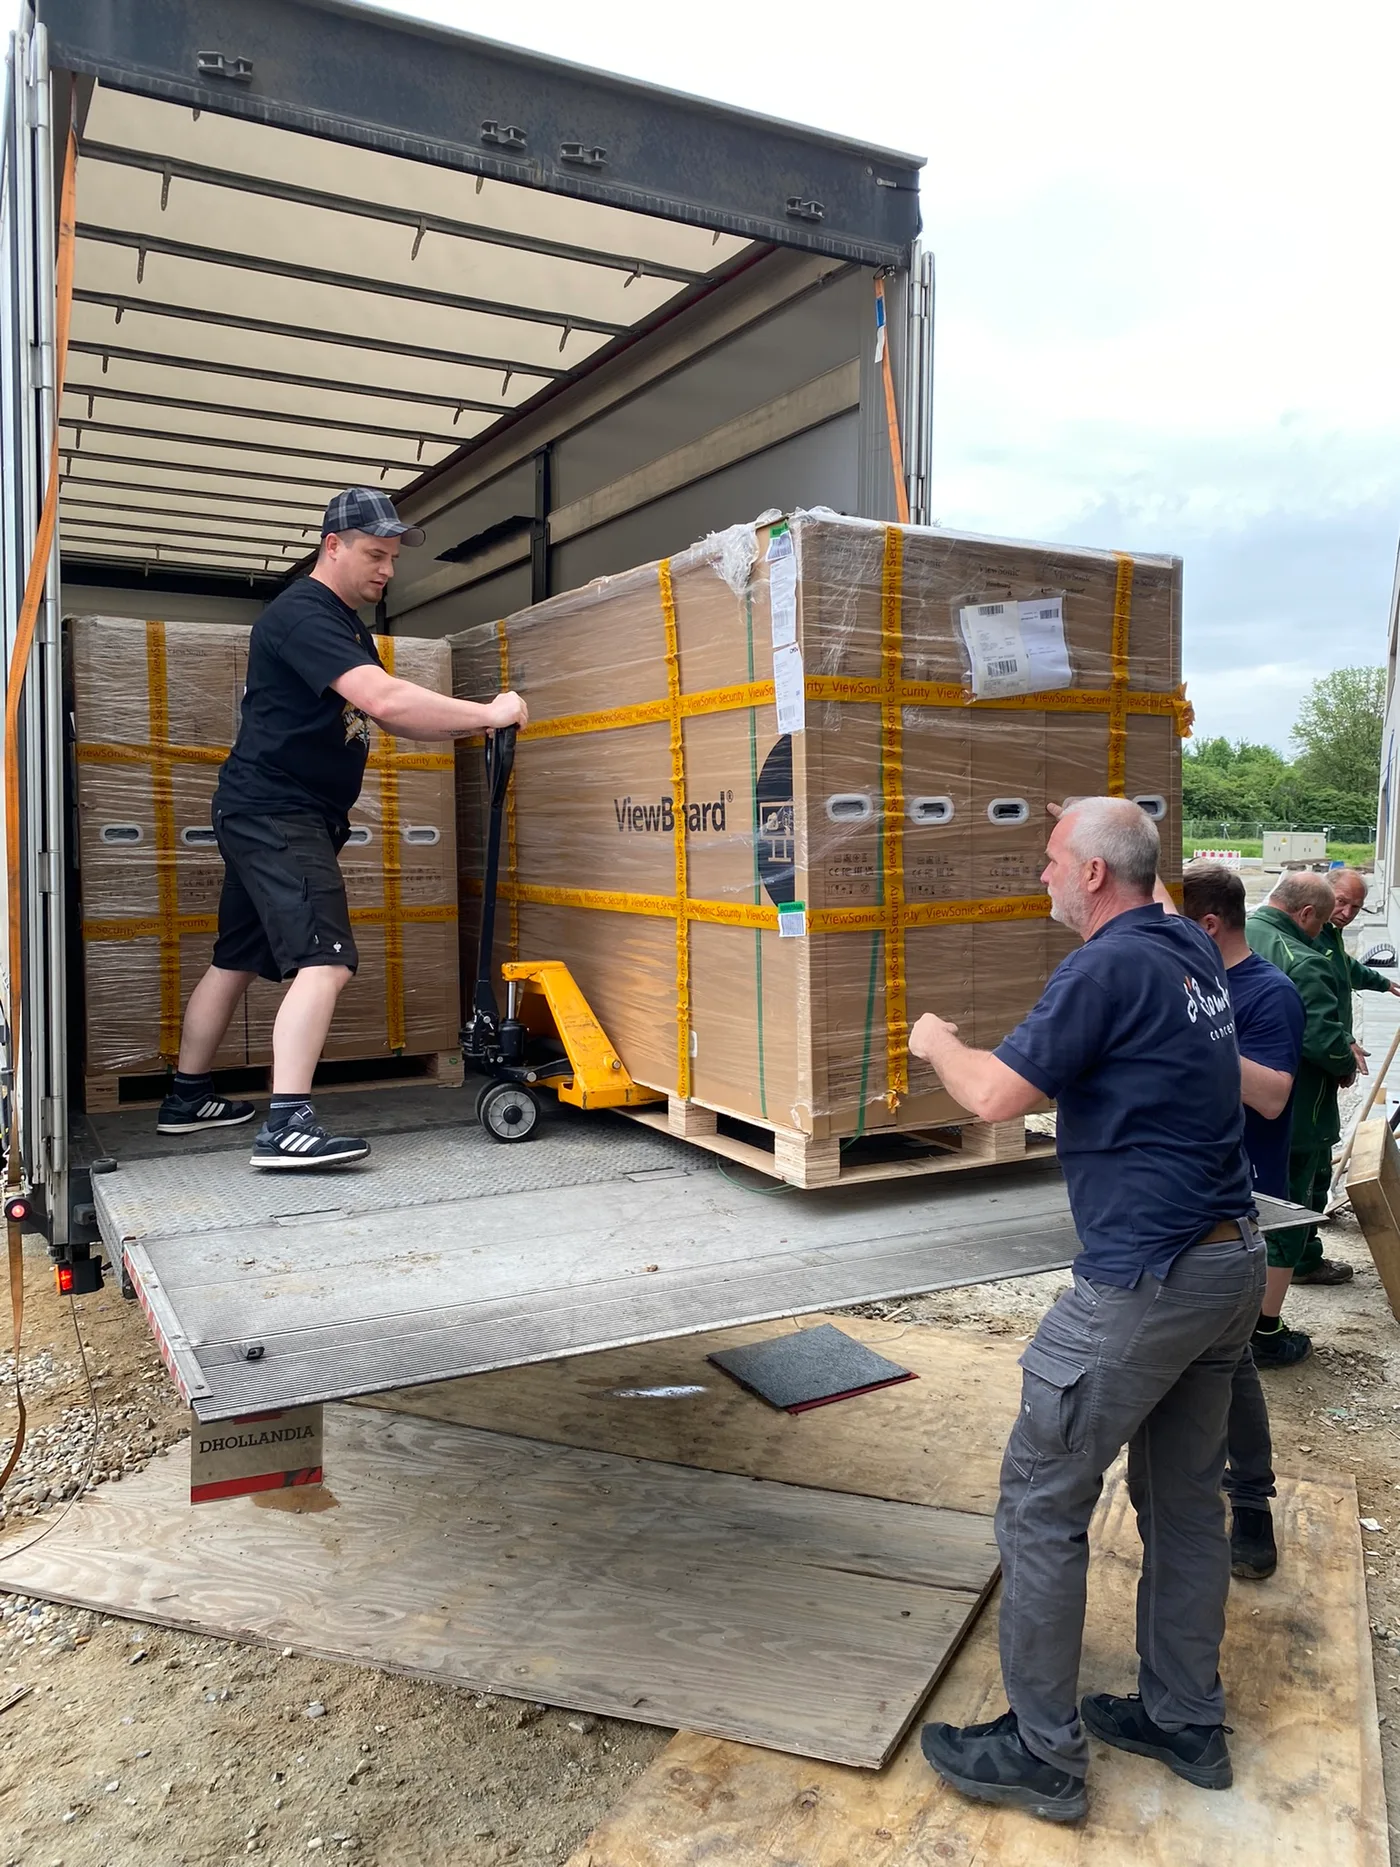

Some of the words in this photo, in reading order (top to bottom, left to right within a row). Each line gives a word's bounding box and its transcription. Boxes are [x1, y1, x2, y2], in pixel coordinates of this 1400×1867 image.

[887, 528, 897, 567] Securi
[887, 571, 897, 637] ViewSonic
[152, 626, 161, 677] ViewSonic
[886, 645, 897, 693] Security
[154, 682, 164, 721] Security
[687, 695, 718, 709] ViewSonic
[718, 690, 745, 703] Security
[748, 684, 775, 698] ViewSo
[806, 679, 825, 695] rity
[901, 684, 930, 700] curity
[937, 686, 968, 701] ViewS
[1033, 691, 1079, 705] ViewSonic
[1081, 693, 1111, 706] Securit
[1127, 697, 1163, 709] iewSonic
[887, 697, 895, 758] ViewSonic
[172, 748, 209, 759] wSonic
[396, 755, 430, 767] Security
[677, 838, 685, 883] Security
[888, 816, 897, 877] ViewSonic
[178, 919, 210, 929] ecurity
[360, 911, 387, 920] Securi
[400, 908, 444, 919] ViewSonic
[717, 907, 742, 921] Security
[745, 909, 774, 923] ViewSon
[822, 912, 876, 925] ViewSonic
[926, 906, 975, 919] ViewSonic
[977, 902, 1016, 916] Security
[1021, 898, 1050, 912] ViewS
[890, 884, 900, 934] Security
[166, 954, 176, 993] Security
[890, 938, 900, 1000] ViewSonic
[199, 1425, 315, 1454] DHOLLANDIA
